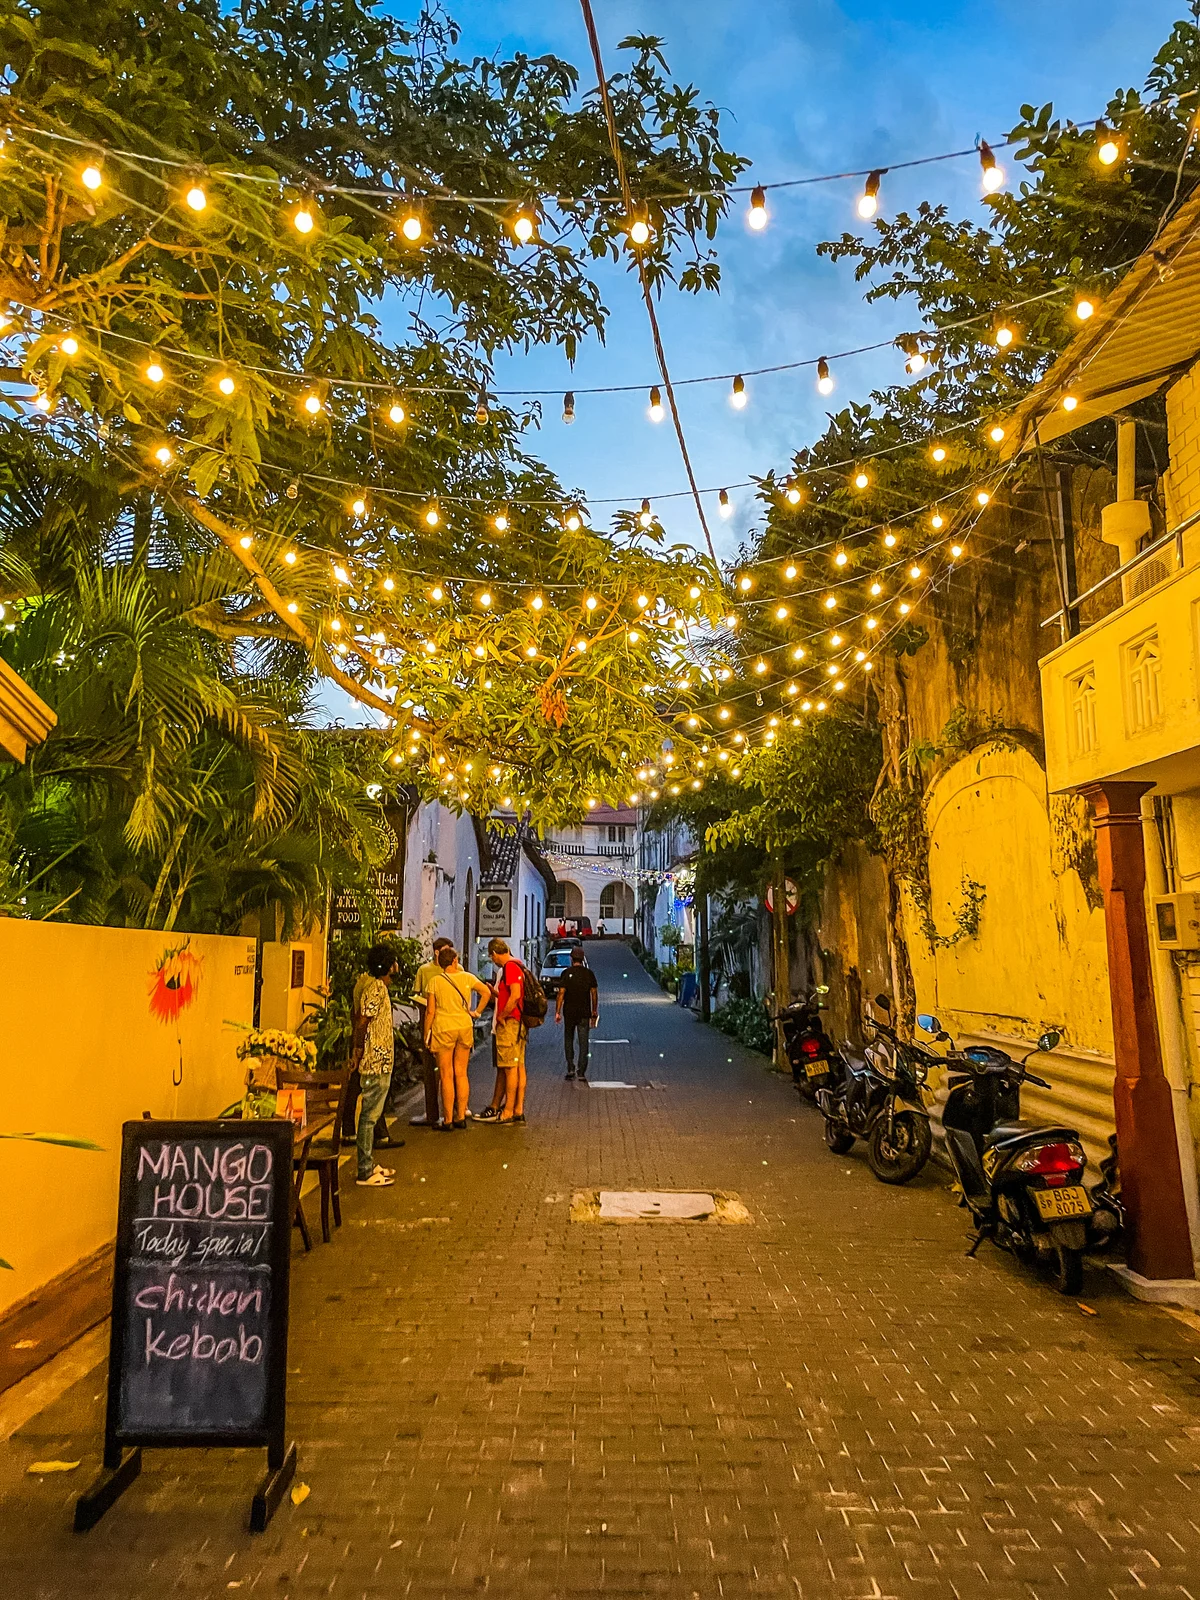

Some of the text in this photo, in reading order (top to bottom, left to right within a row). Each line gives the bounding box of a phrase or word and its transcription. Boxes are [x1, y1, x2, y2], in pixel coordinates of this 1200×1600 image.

[337, 911, 360, 923] FOOD
[137, 1143, 273, 1184] MANGO
[153, 1182, 271, 1220] HOUSE
[1056, 1201, 1084, 1215] 8075
[135, 1223, 267, 1266] Today special
